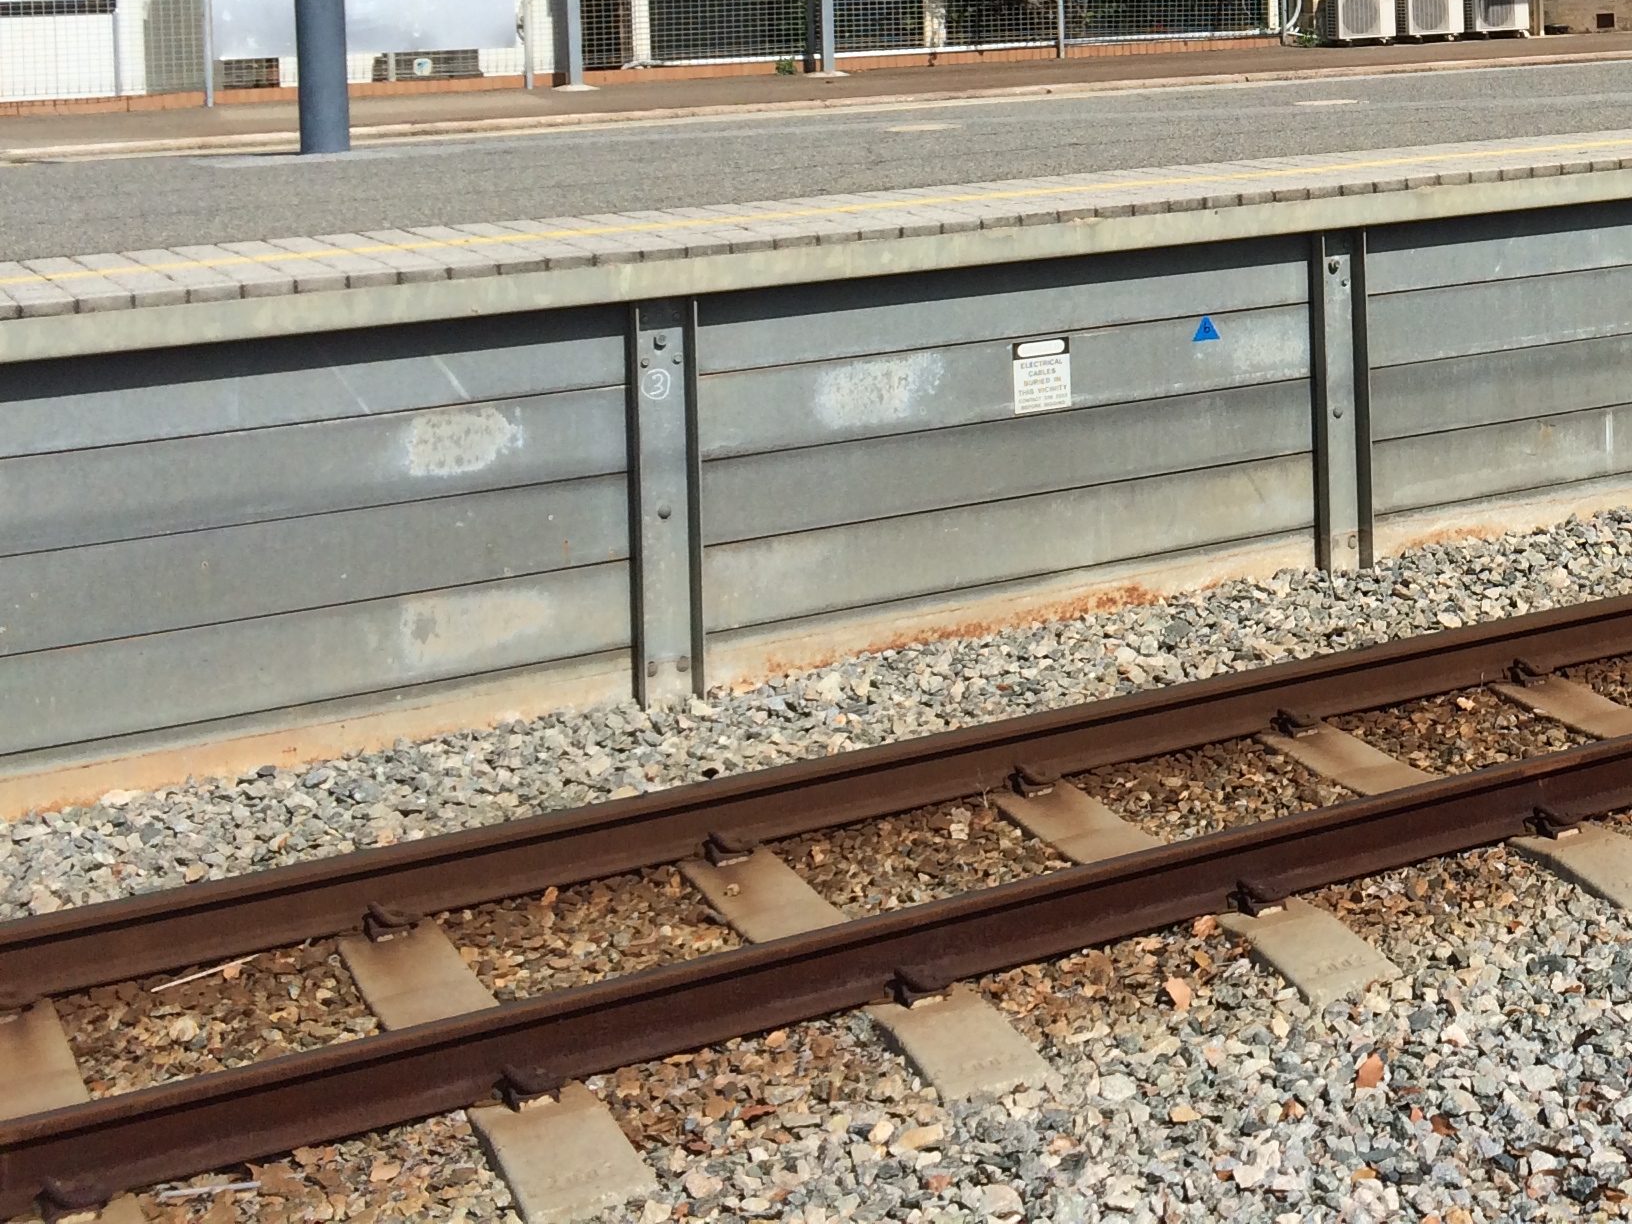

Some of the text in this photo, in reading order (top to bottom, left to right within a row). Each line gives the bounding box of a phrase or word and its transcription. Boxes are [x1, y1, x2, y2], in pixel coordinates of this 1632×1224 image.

[1020, 359, 1062, 369] ELECTRICAL
[1028, 368, 1056, 377] CABLES
[651, 373, 664, 395] 3
[1023, 378, 1050, 386] BURIED
[1018, 384, 1067, 396] THIS VICINITY
